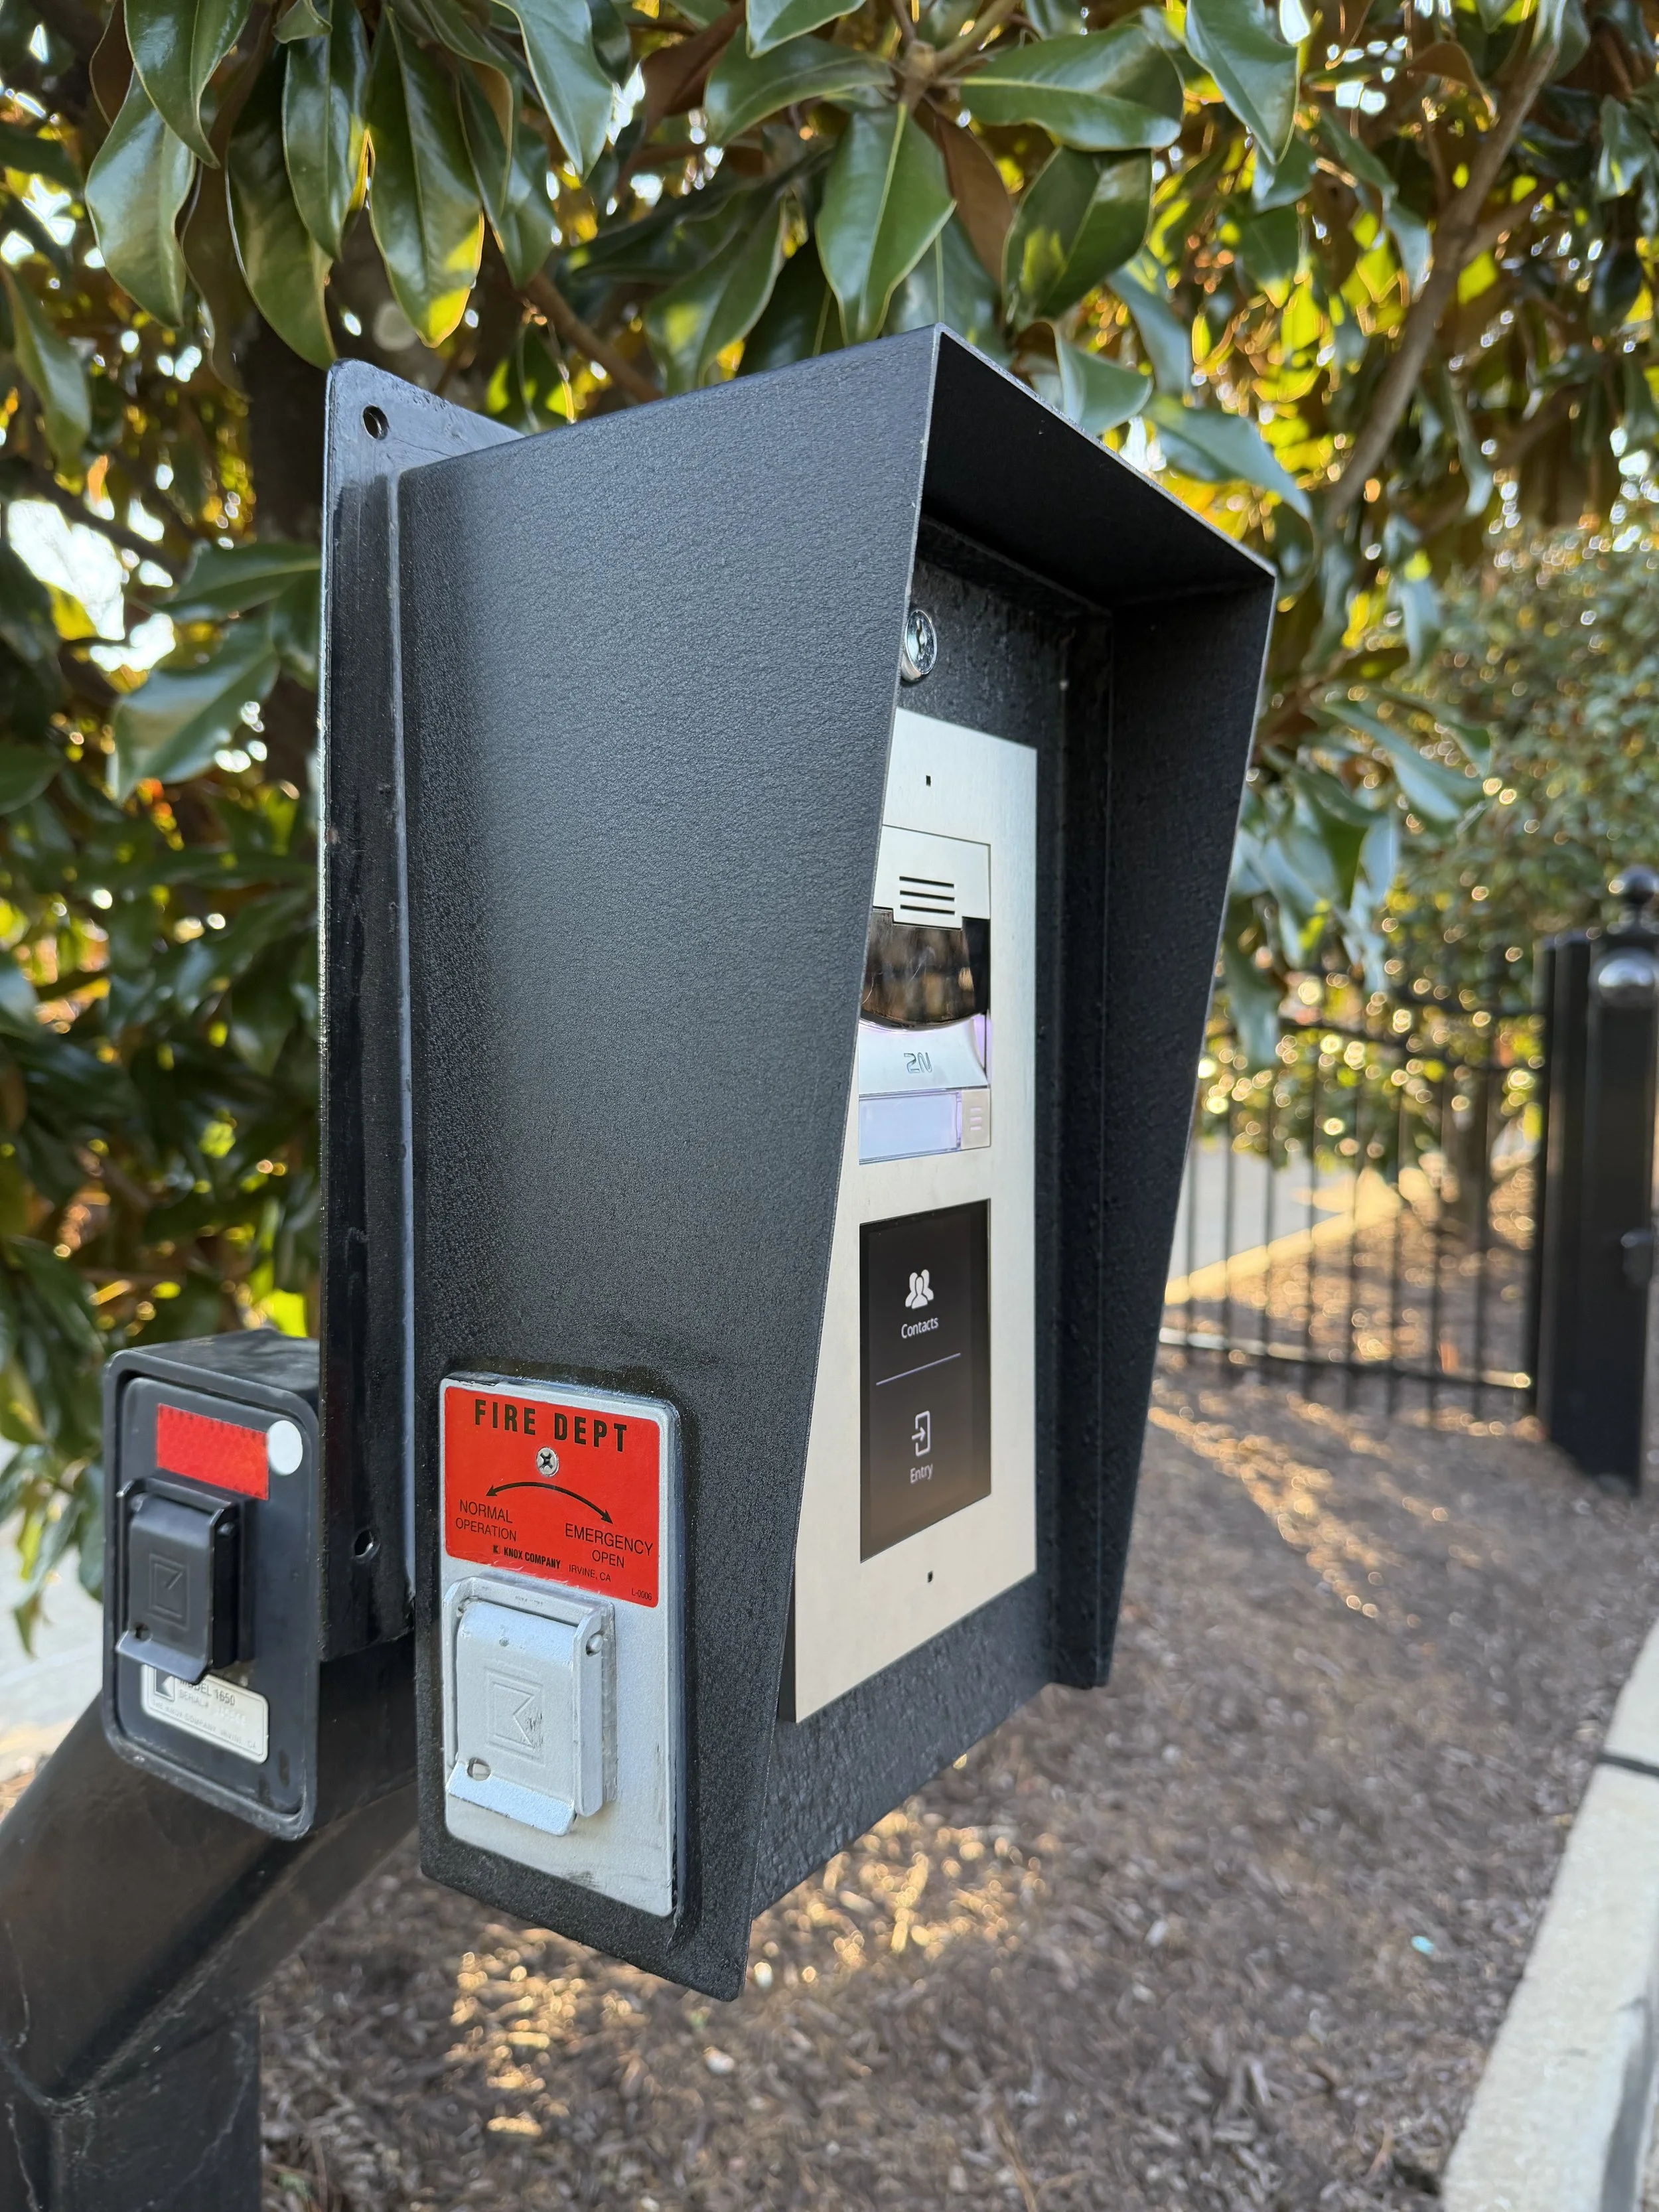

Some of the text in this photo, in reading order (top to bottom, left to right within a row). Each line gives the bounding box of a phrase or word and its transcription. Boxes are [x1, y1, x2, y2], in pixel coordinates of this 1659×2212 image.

[903, 1052, 932, 1073] 2N
[901, 1317, 939, 1339] Contacts
[474, 1399, 627, 1452] FIRE DEPT
[910, 1463, 933, 1484] Entry
[460, 1499, 513, 1524] NORMAL
[455, 1517, 516, 1542] OPERATION
[565, 1523, 654, 1556] EMERGENCY
[504, 1546, 523, 1560] KNOX
[525, 1552, 561, 1569] COMPANY
[569, 1564, 598, 1580] IRVINE,
[599, 1572, 611, 1582] CA
[591, 1550, 624, 1568] OPEN
[631, 1587, 652, 1601] L-0006
